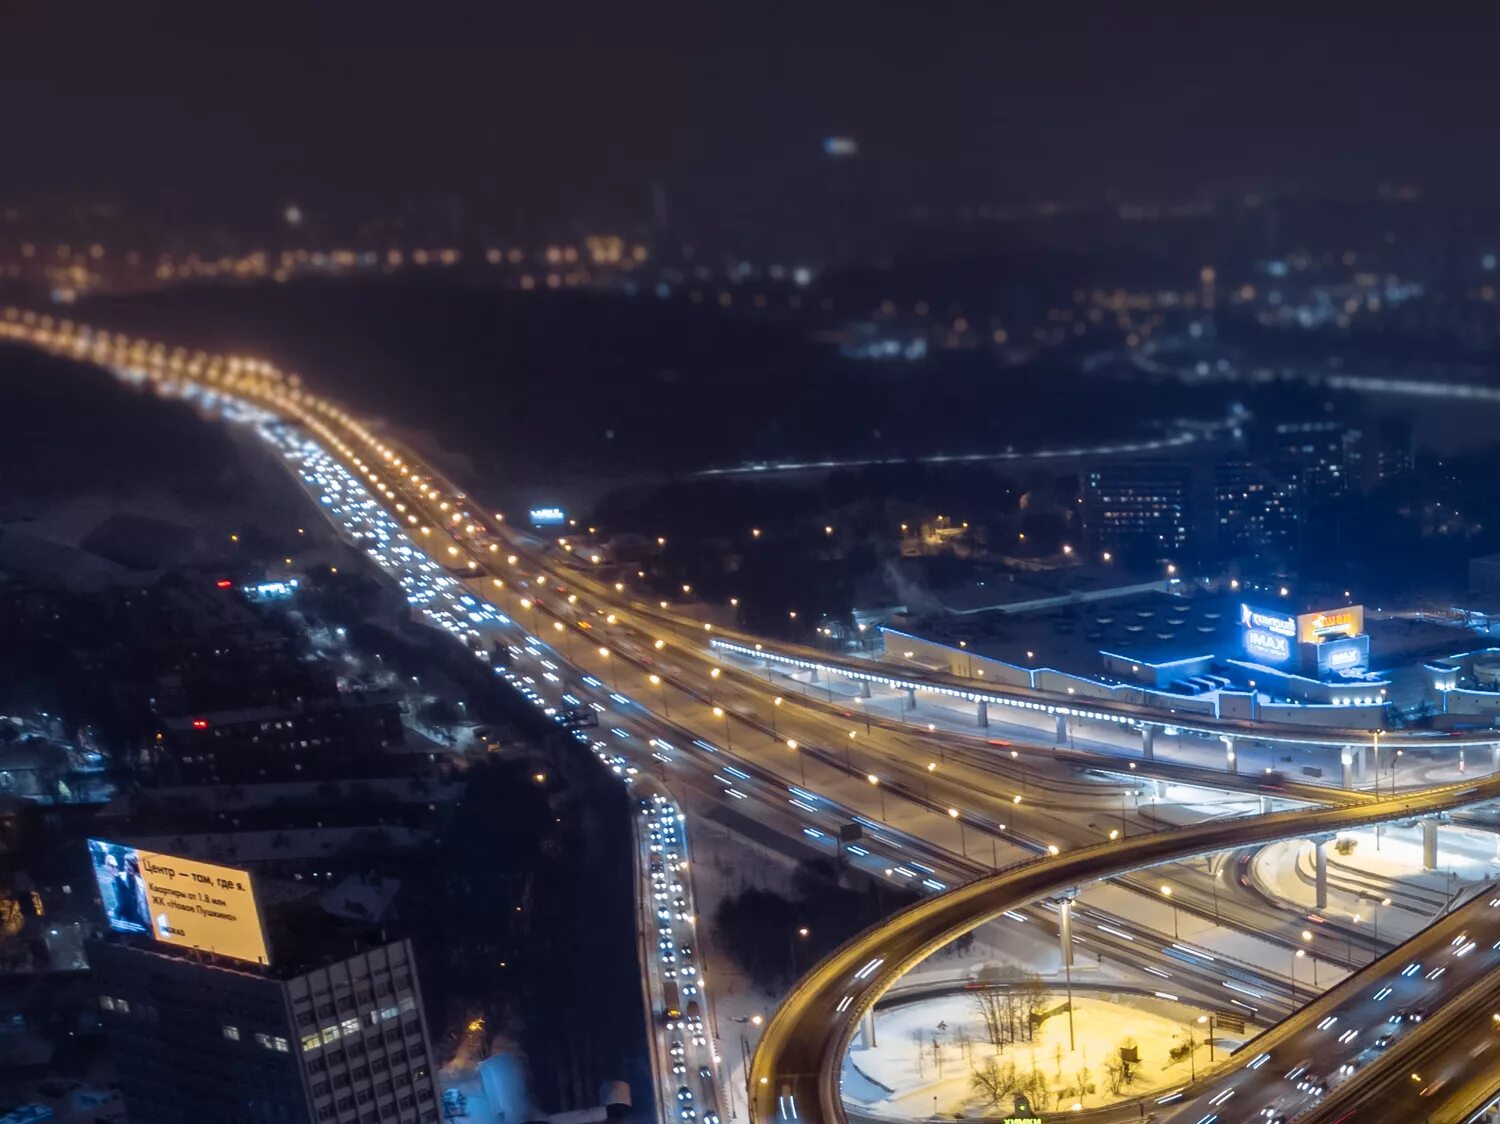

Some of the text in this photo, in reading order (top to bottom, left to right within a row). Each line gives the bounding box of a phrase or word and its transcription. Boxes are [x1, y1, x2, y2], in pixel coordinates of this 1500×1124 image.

[1250, 632, 1285, 650] IMAX
[142, 860, 176, 881] Центр
[191, 873, 214, 887] там,
[217, 878, 234, 890] где
